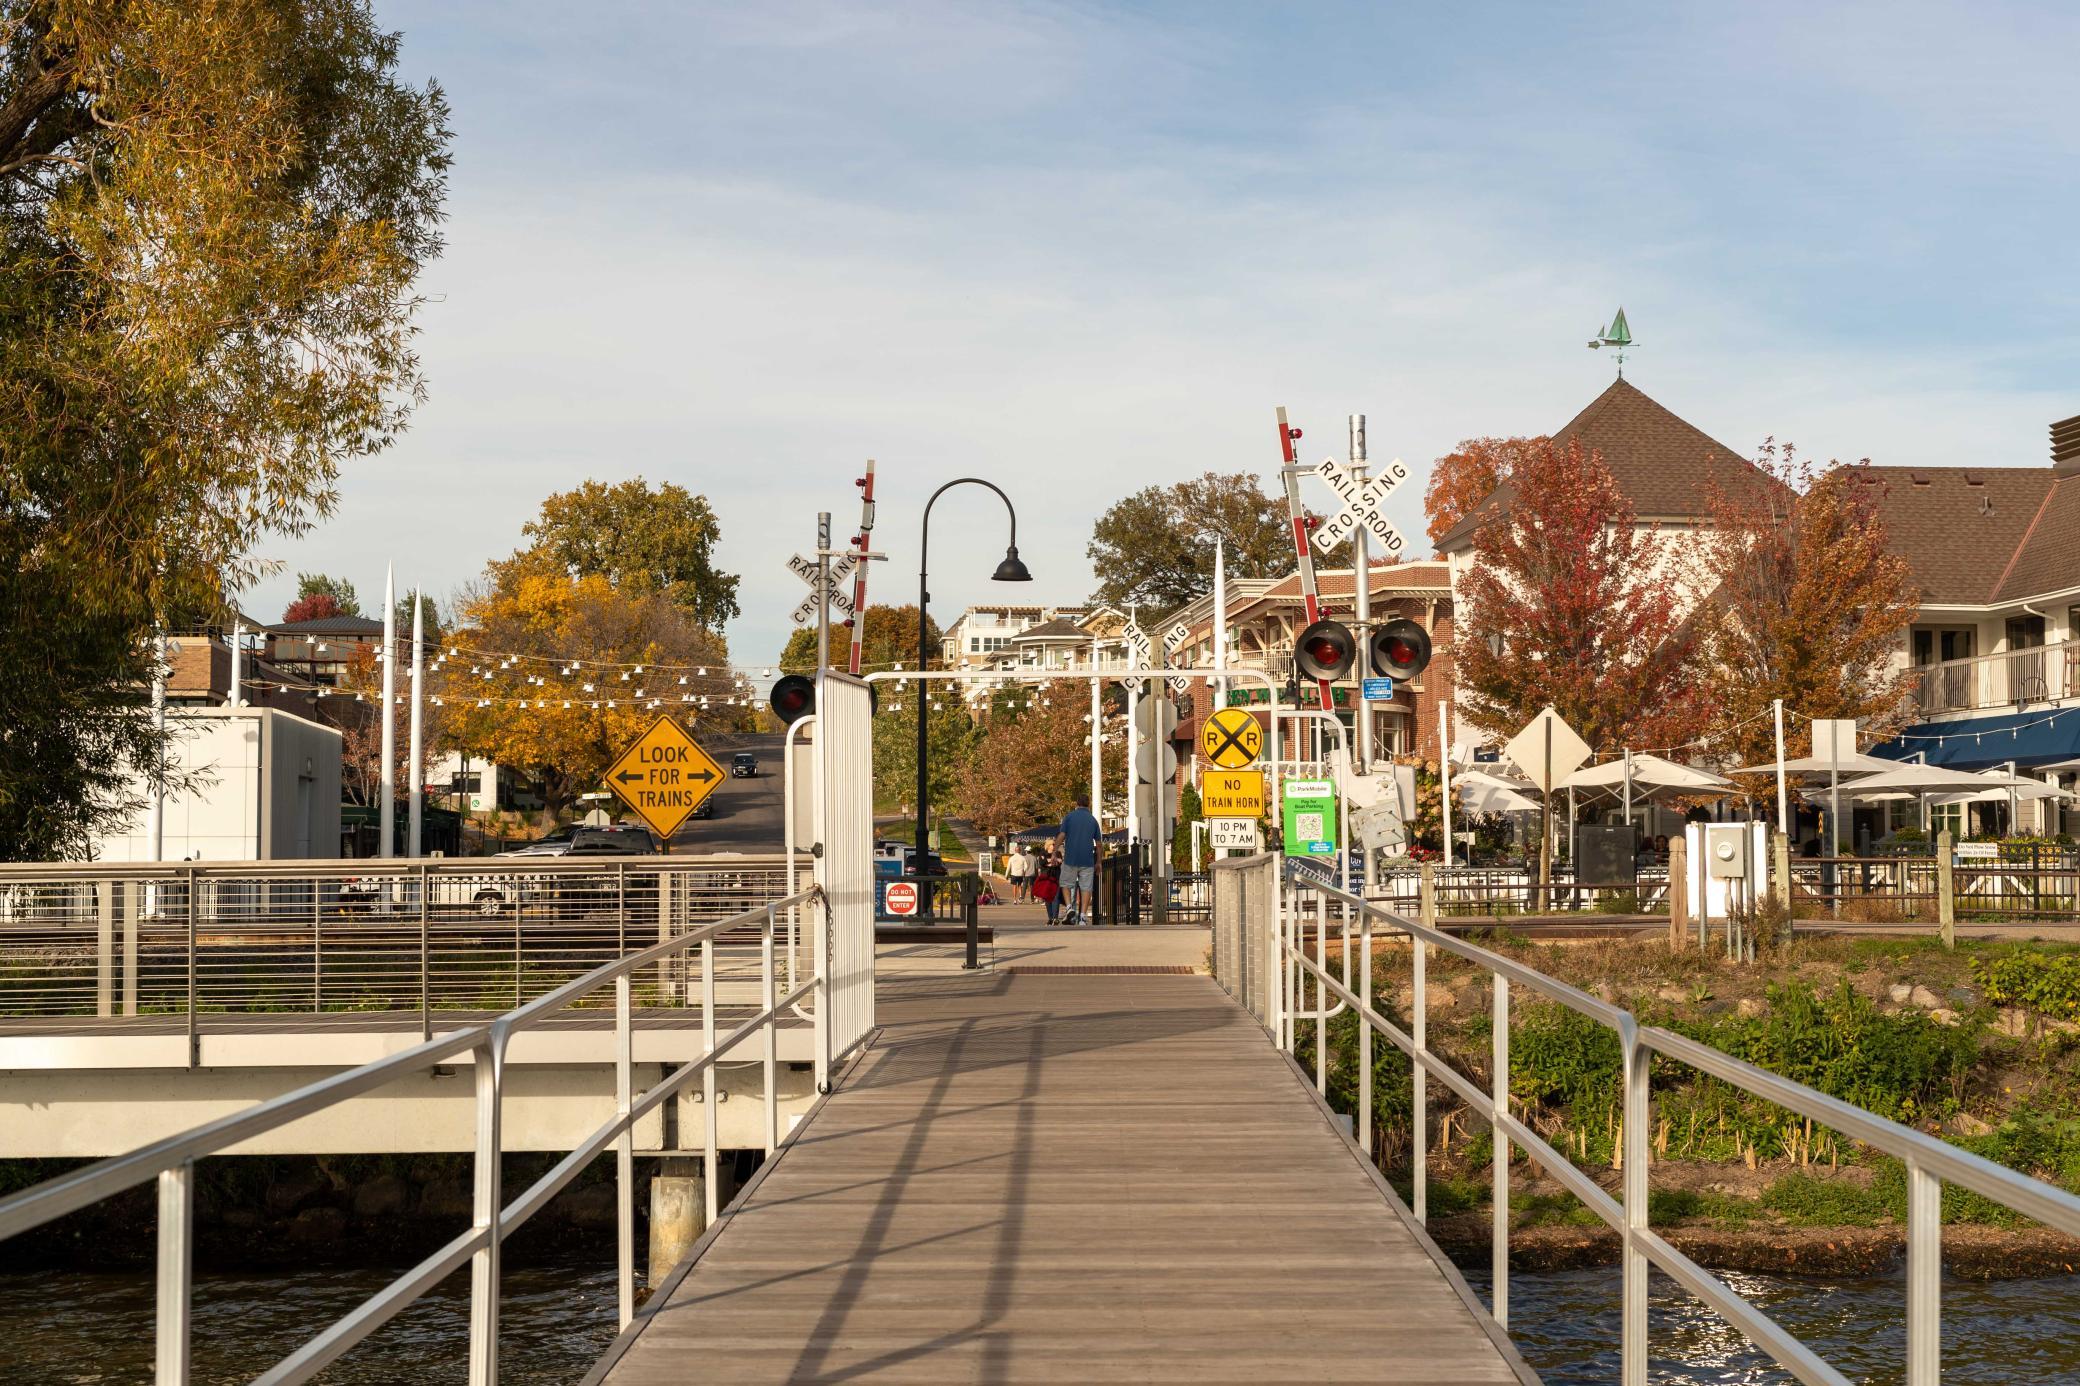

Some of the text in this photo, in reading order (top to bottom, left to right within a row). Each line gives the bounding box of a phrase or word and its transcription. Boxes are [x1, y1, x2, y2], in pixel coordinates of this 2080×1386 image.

[1317, 464, 1406, 548] CROSSING
[794, 555, 857, 623] CROSING
[1207, 732, 1257, 746] R R
[640, 746, 688, 763] LOOK
[650, 768, 680, 785] FOR
[1224, 779, 1241, 791] NO
[637, 790, 693, 807] TRAINS
[1207, 797, 1260, 808] TRAIN HORN
[1220, 822, 1247, 831] 10 PM
[1214, 834, 1253, 843] TO 7 AM
